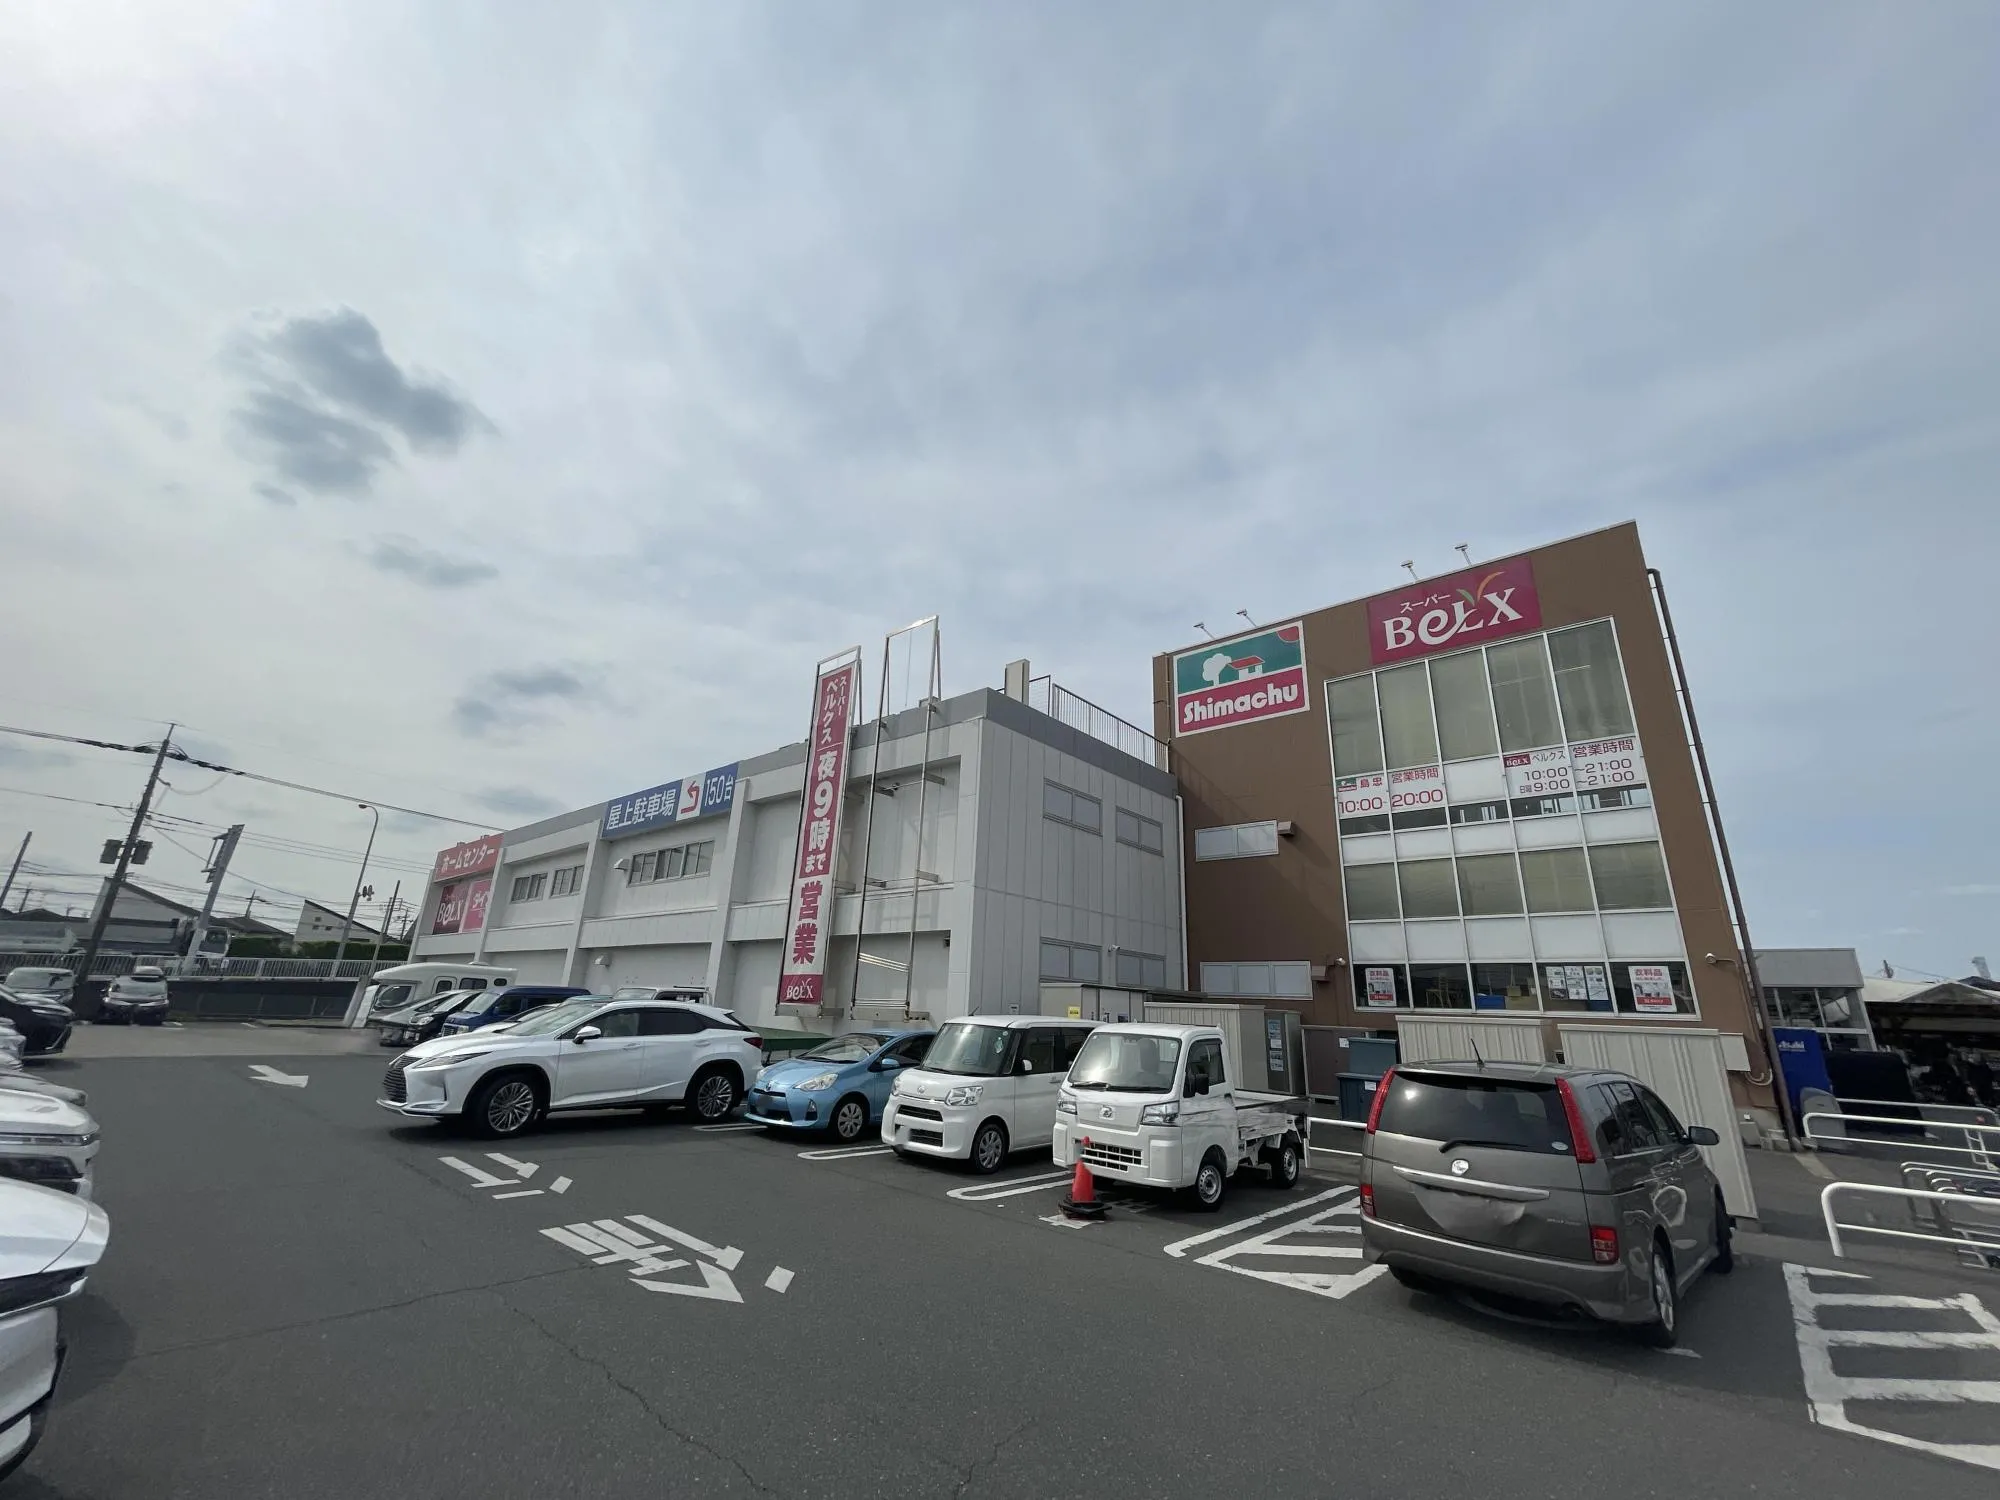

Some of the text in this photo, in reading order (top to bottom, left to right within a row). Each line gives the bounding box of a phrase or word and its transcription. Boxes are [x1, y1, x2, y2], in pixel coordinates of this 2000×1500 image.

[1400, 593, 1450, 614] スーパー
[838, 676, 847, 716] スーパー
[1183, 683, 1298, 725] Shimachu
[821, 679, 838, 745] ベルクス
[1532, 751, 1565, 762] ベルクス
[1573, 739, 1634, 759] 営業時間
[1391, 768, 1439, 785] 営業時間
[1525, 767, 1568, 781] 10:00
[1533, 779, 1570, 792] 9:00
[606, 774, 734, 831] 屋上駐車場 150台
[441, 843, 495, 874] ホームセンター
